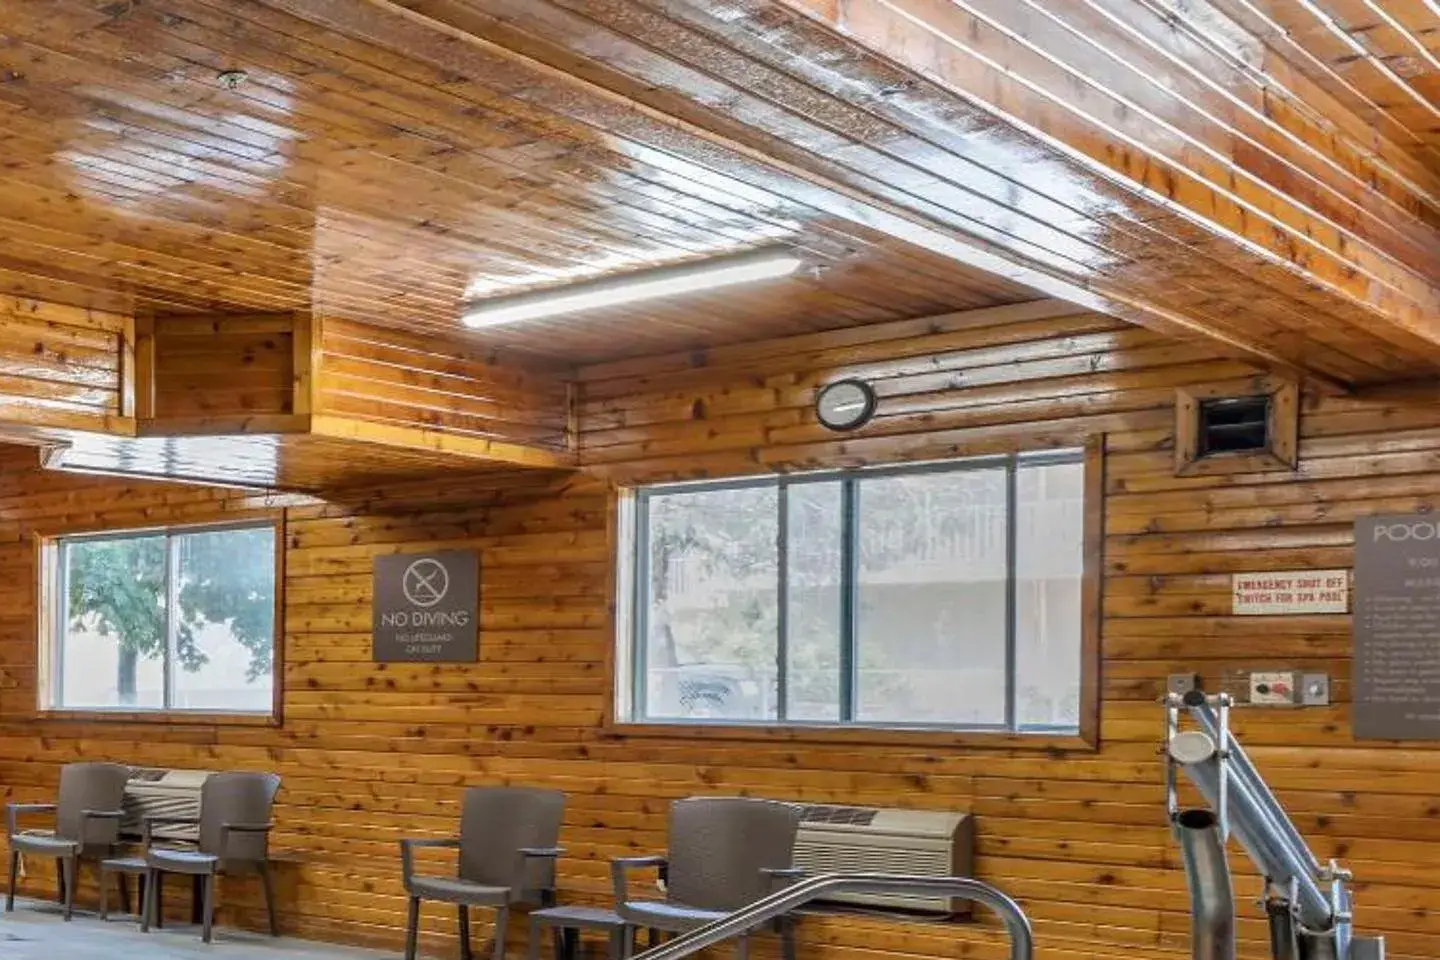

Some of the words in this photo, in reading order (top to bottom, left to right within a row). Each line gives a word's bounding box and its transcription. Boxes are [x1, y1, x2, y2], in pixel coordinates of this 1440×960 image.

[1326, 577, 1344, 588] OFF
[1276, 593, 1293, 603] FOR
[381, 612, 408, 627] NO
[412, 610, 469, 627] DIVING
